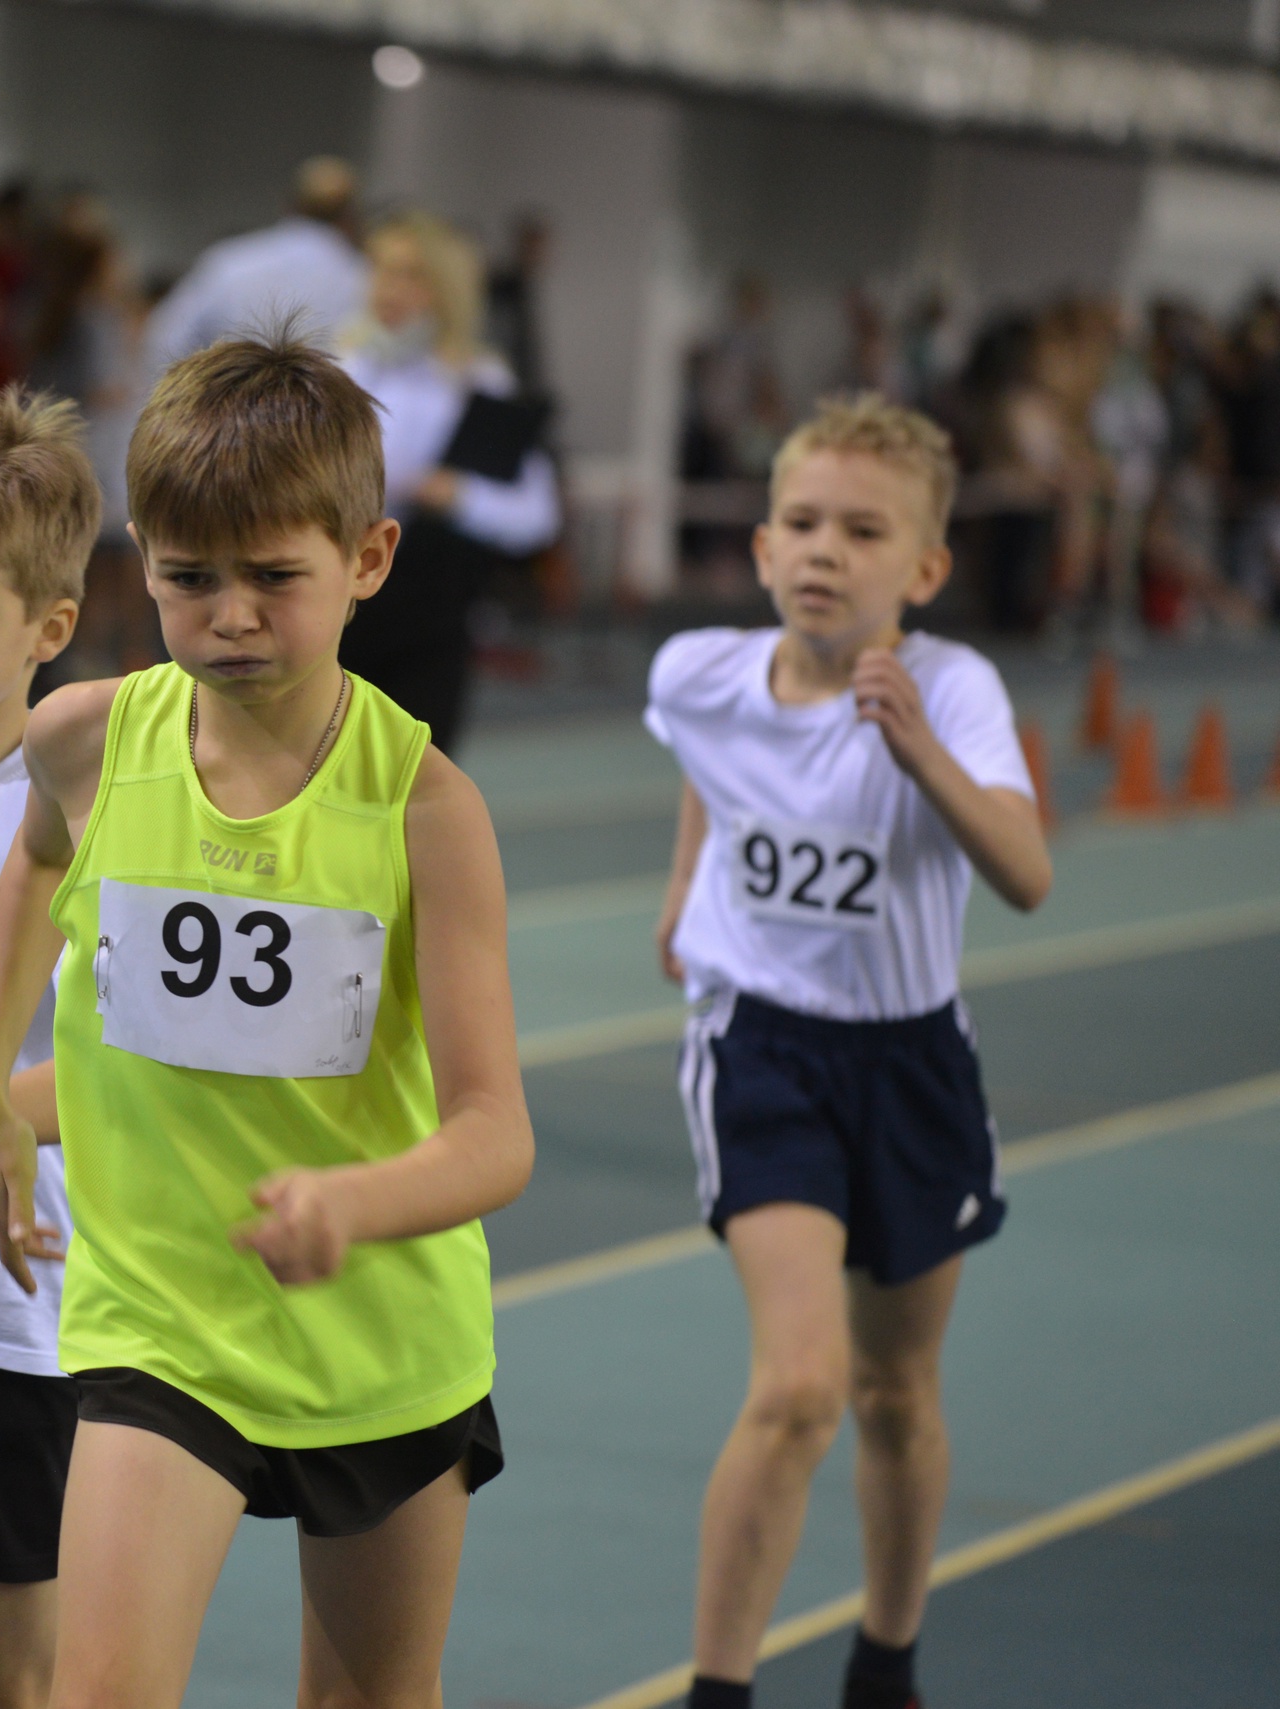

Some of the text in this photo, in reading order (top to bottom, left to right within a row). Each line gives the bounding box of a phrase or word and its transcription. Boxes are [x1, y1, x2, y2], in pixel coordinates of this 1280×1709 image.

[199, 839, 250, 873] RUN
[743, 831, 877, 915] 922
[161, 901, 293, 1007] 93
